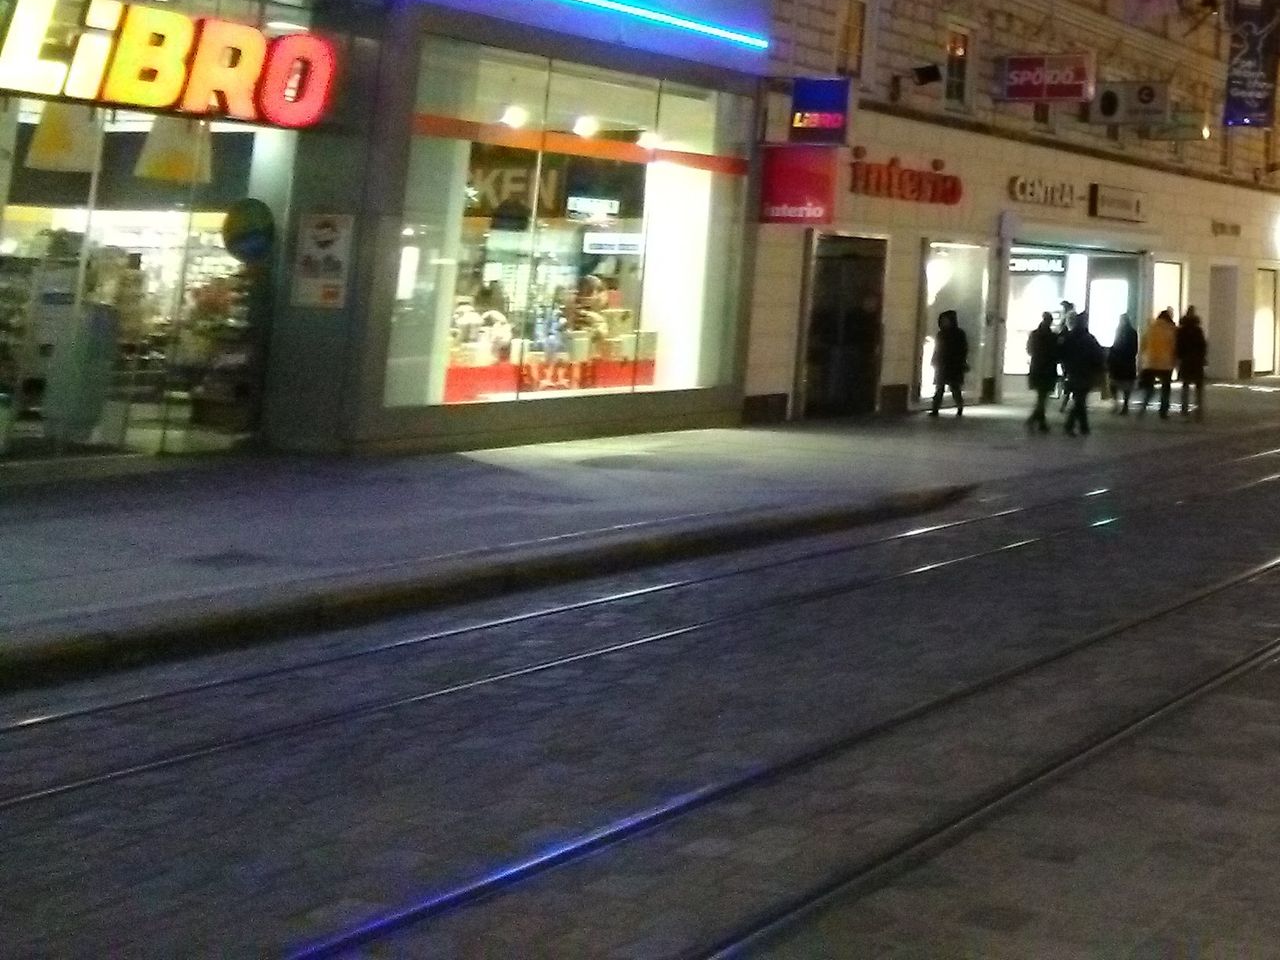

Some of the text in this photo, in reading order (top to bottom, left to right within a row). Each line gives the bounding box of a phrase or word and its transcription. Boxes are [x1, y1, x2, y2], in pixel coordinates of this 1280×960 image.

[851, 145, 962, 205] interio
[1008, 175, 1075, 208] CENTRAL
[1008, 258, 1065, 273] CENTRAL
